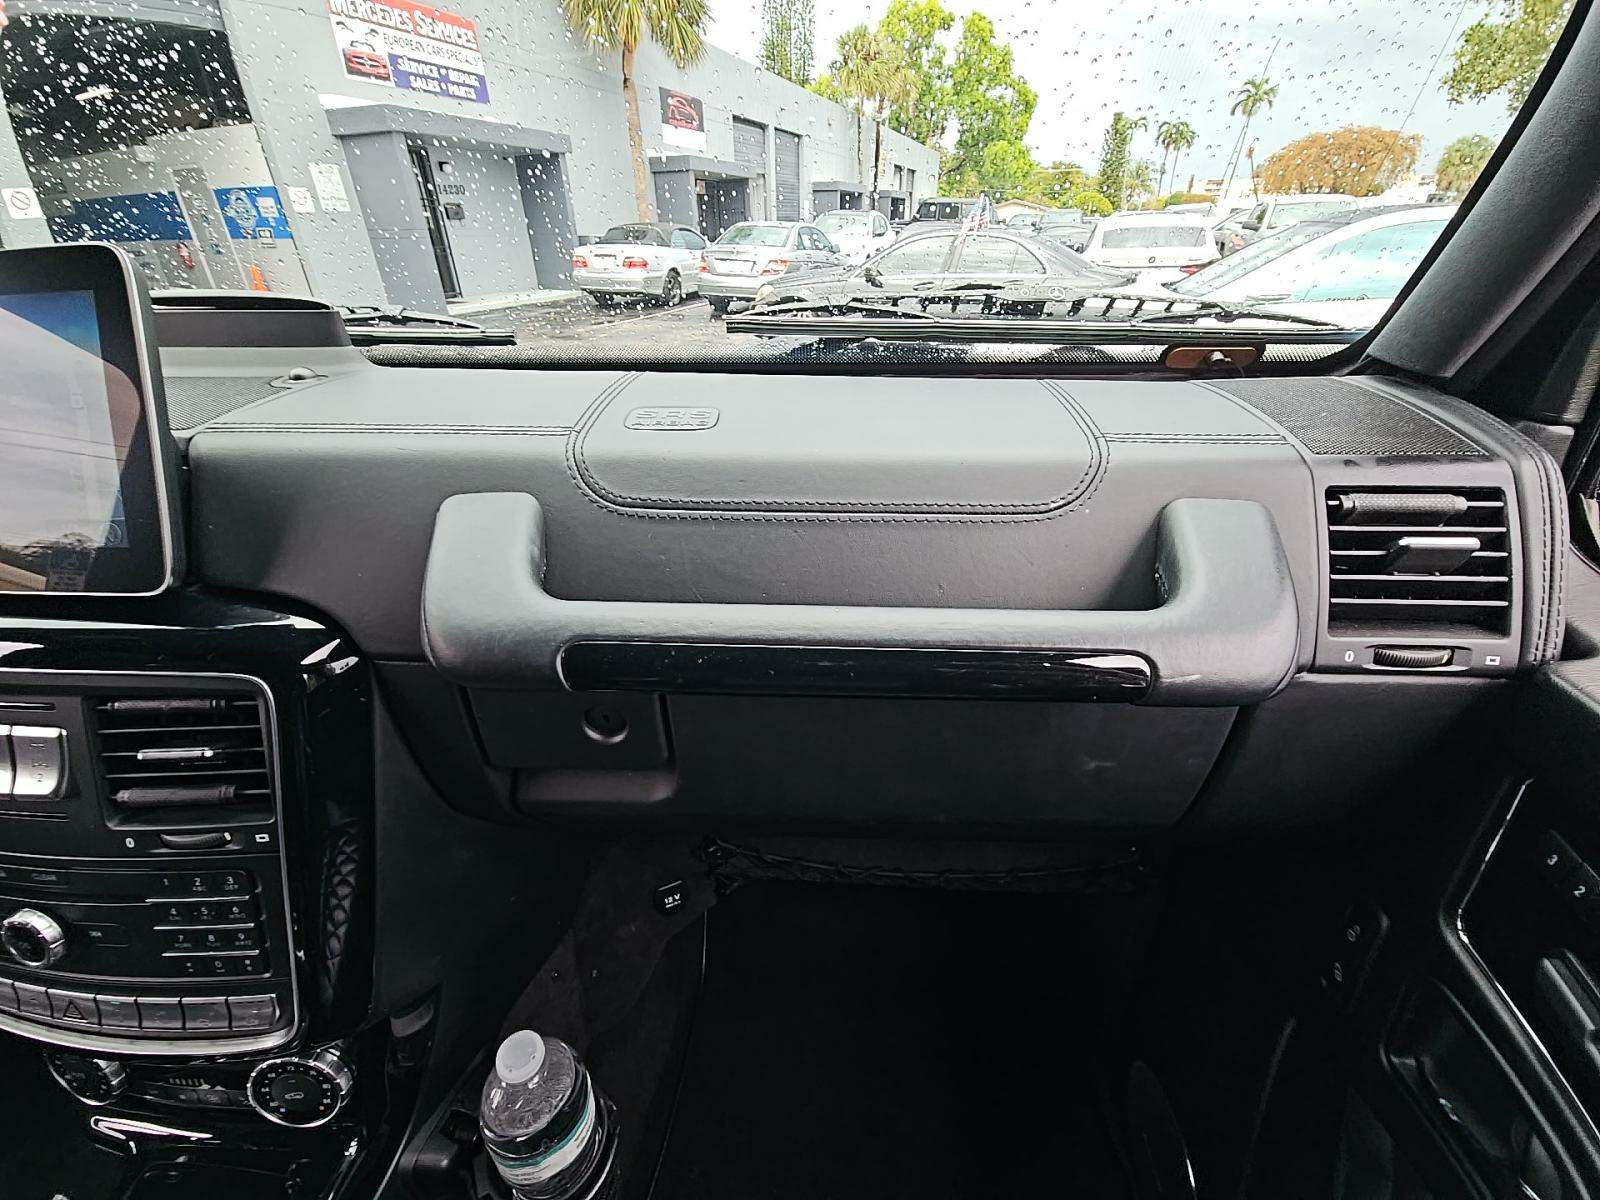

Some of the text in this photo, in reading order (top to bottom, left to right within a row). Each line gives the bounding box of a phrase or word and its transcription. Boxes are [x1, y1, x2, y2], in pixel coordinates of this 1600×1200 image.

[329, 0, 413, 34] MERCEDES
[397, 56, 440, 79] SERVICE
[409, 75, 440, 92] SALES
[437, 183, 466, 196] 14230
[1547, 854, 1558, 865] 3
[194, 877, 201, 886] 2
[226, 876, 234, 884] 3
[1573, 885, 1586, 897] 2
[664, 896, 674, 904] 12
[170, 905, 239, 916] 4 5 6
[177, 933, 245, 943] 7 8 9
